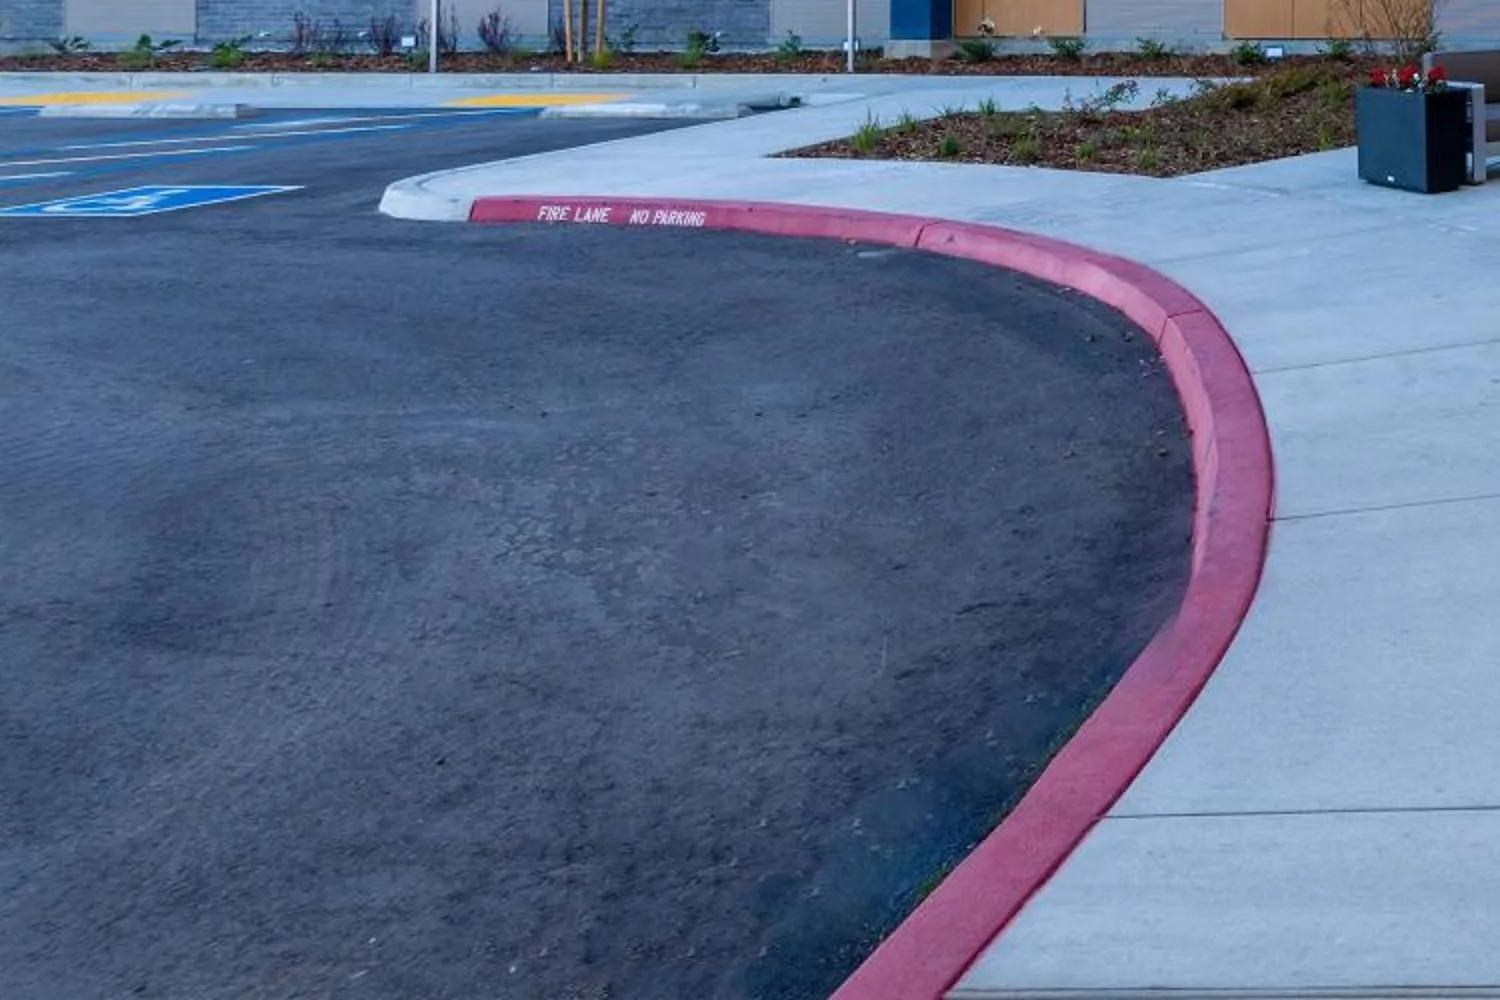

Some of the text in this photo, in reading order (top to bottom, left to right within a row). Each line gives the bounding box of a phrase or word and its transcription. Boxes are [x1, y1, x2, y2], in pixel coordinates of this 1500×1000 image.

[537, 205, 707, 227] FIRE LANE NO PARKING
